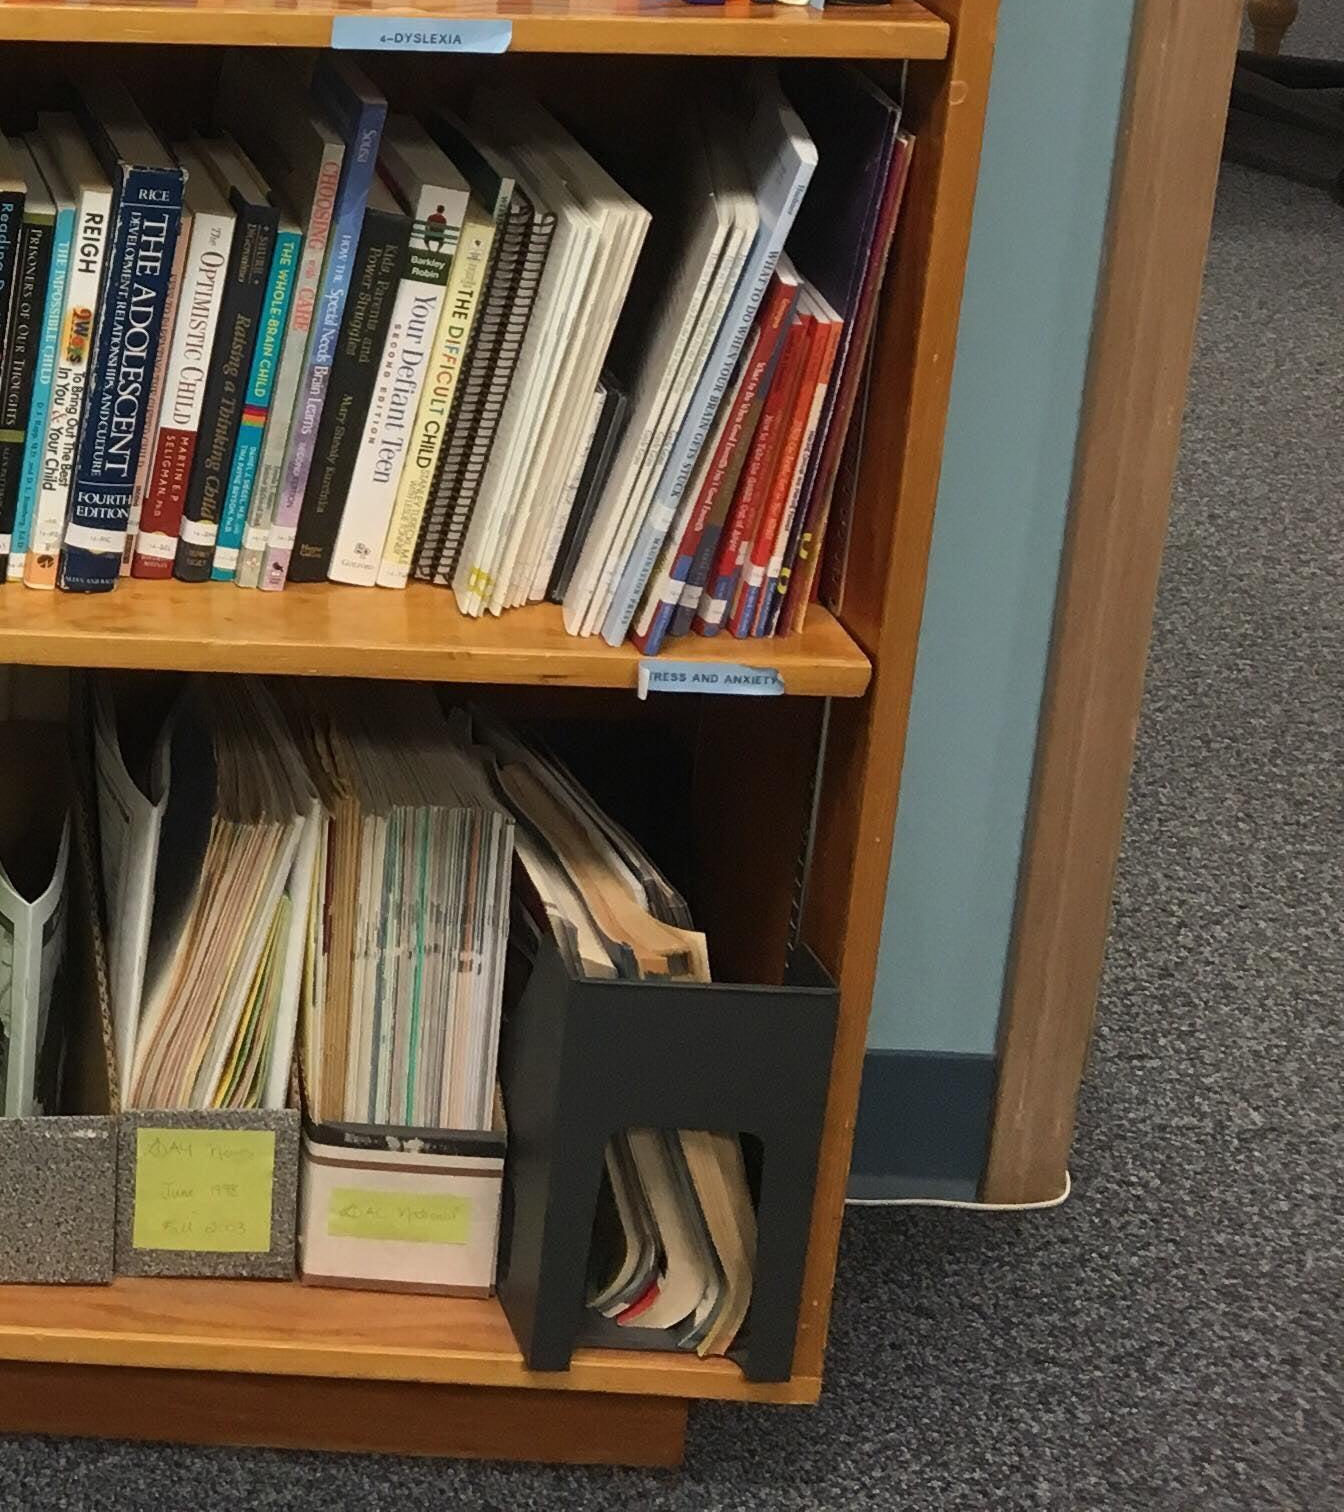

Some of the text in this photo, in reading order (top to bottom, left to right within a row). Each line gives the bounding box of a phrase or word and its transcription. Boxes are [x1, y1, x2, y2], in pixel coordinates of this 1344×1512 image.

[139, 189, 170, 202] RICE
[106, 214, 169, 477] THE ADOLESCENT
[373, 296, 437, 484] Your Defiant Teen
[692, 673, 778, 686] AND ANXIETY
